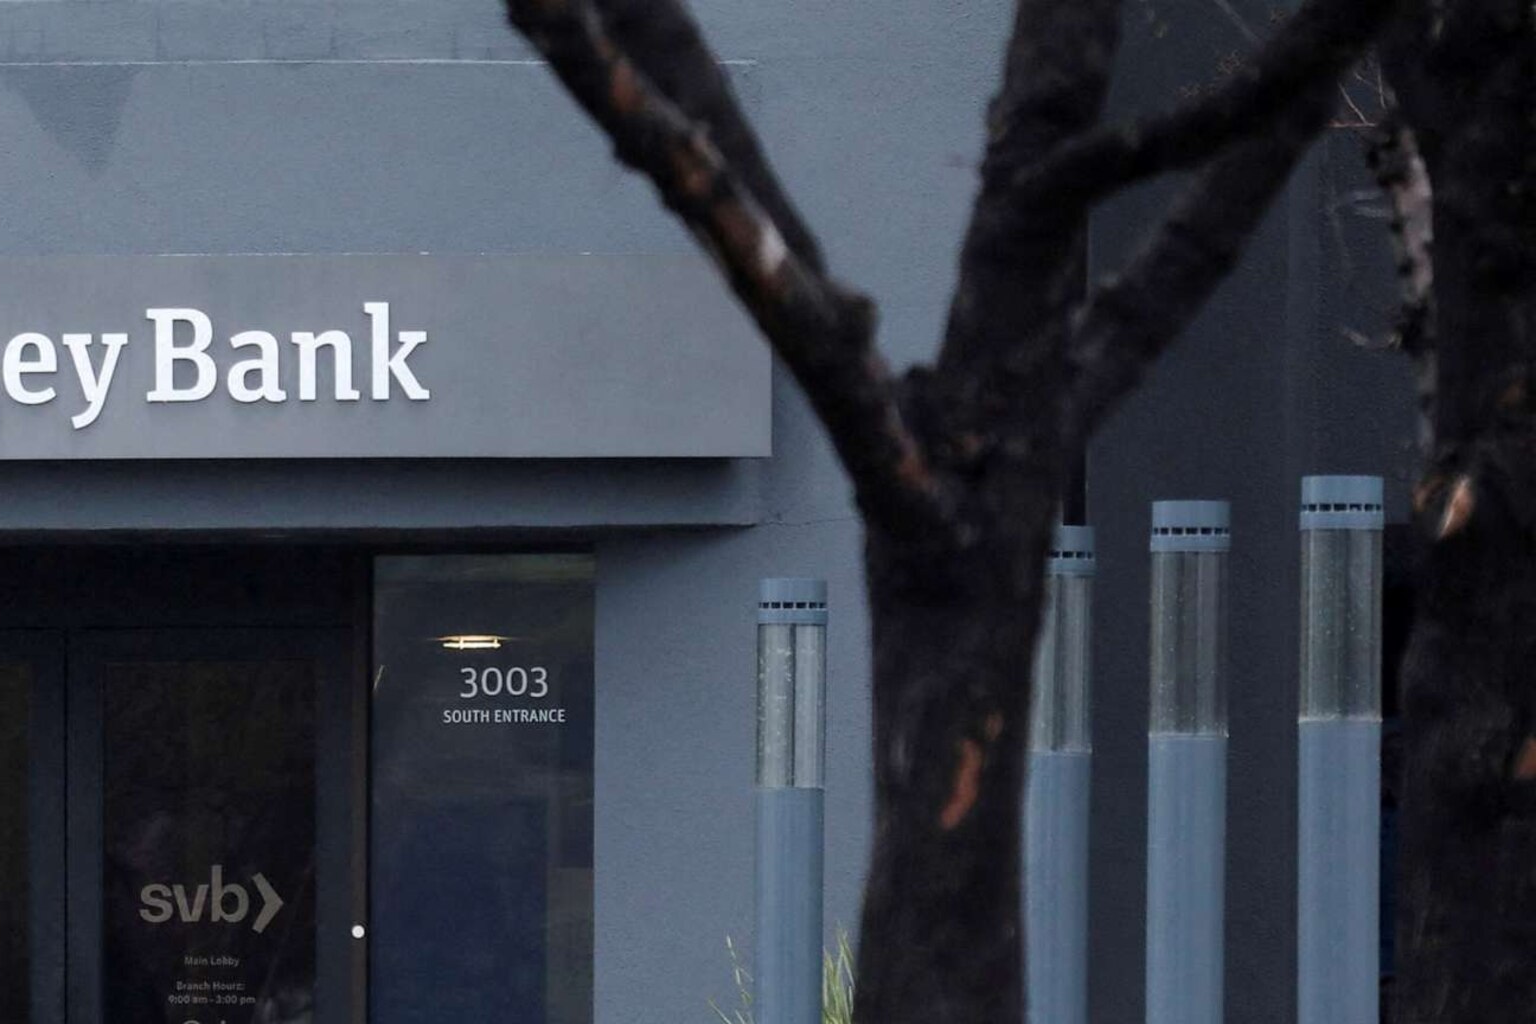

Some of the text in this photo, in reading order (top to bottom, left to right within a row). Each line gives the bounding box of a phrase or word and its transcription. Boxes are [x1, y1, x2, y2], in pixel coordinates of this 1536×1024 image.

[146, 301, 431, 404] Bank
[460, 666, 549, 699] 3003
[443, 708, 566, 724] SOUTH ENTRANCE
[138, 864, 250, 924] svb
[184, 955, 240, 968] Main Lobby
[176, 981, 210, 991] Branch
[168, 994, 191, 1004] 9:00
[192, 996, 208, 1004] am
[239, 996, 256, 1006] pm
